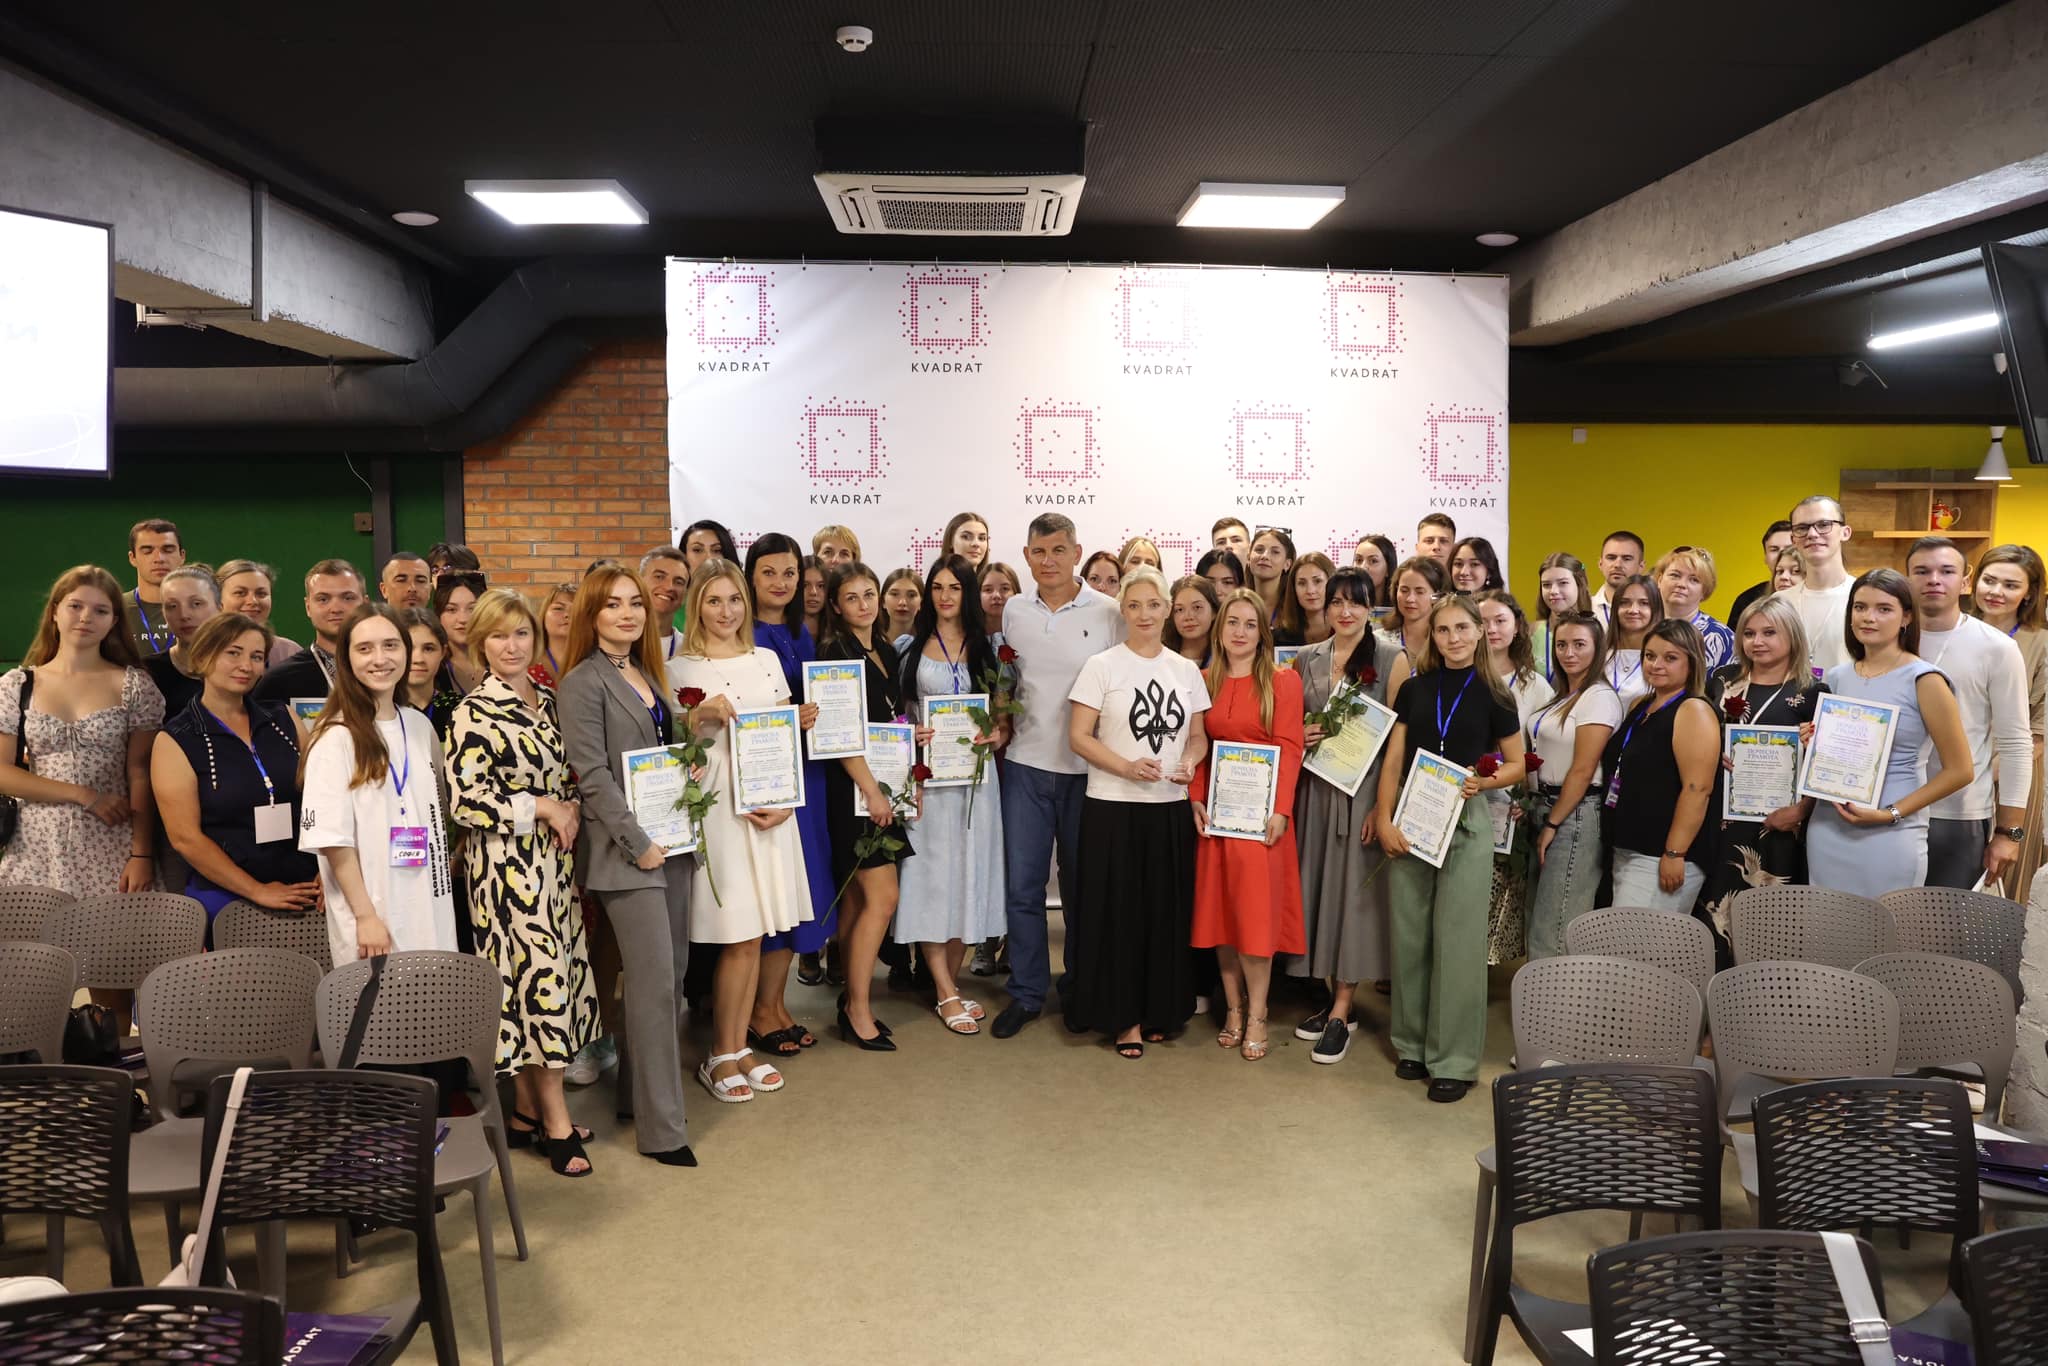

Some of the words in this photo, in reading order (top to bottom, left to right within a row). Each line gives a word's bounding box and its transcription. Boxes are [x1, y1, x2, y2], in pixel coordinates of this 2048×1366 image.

[698, 361, 771, 372] KVADRAT
[911, 362, 983, 373] KVADRAT
[1123, 365, 1193, 376] KVADRAT
[1330, 368, 1399, 379] KVADRAT
[809, 494, 882, 505] KVADRAT
[1025, 494, 1096, 505] KVADRAT
[1236, 495, 1305, 506] KVADRAT
[1429, 497, 1497, 508] KVADRAT
